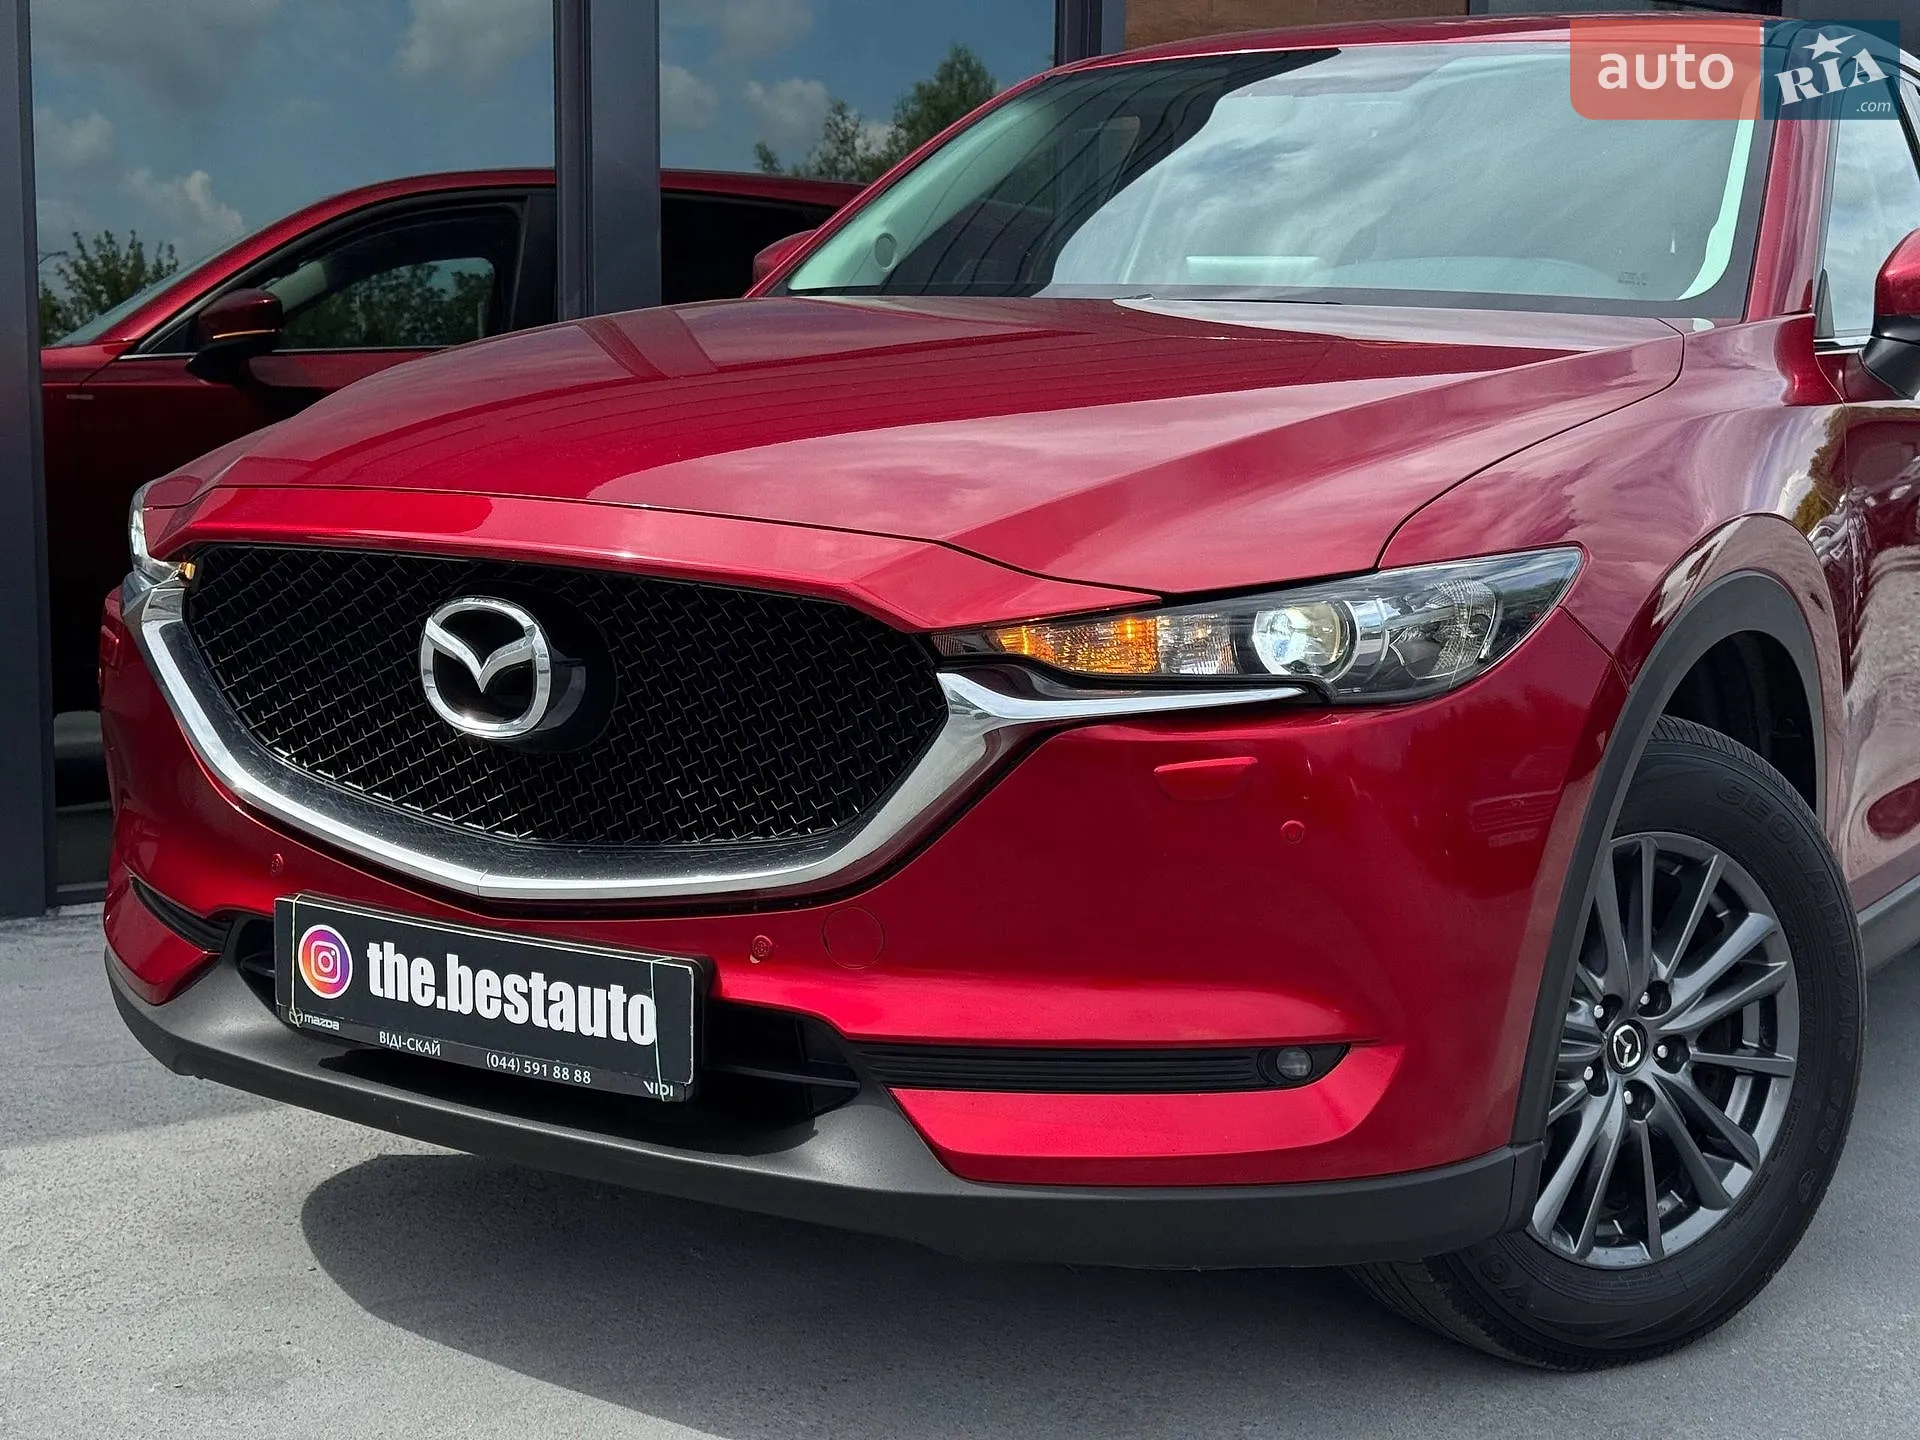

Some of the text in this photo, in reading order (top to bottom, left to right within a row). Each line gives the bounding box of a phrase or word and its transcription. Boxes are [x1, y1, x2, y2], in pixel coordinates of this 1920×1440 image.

[366, 941, 657, 1046] the.bestauto
[379, 1030, 442, 1057] ВІДІ-СКАЙ
[486, 1052, 591, 1084] (044) 591 88 88
[642, 1080, 674, 1097] VIDI
